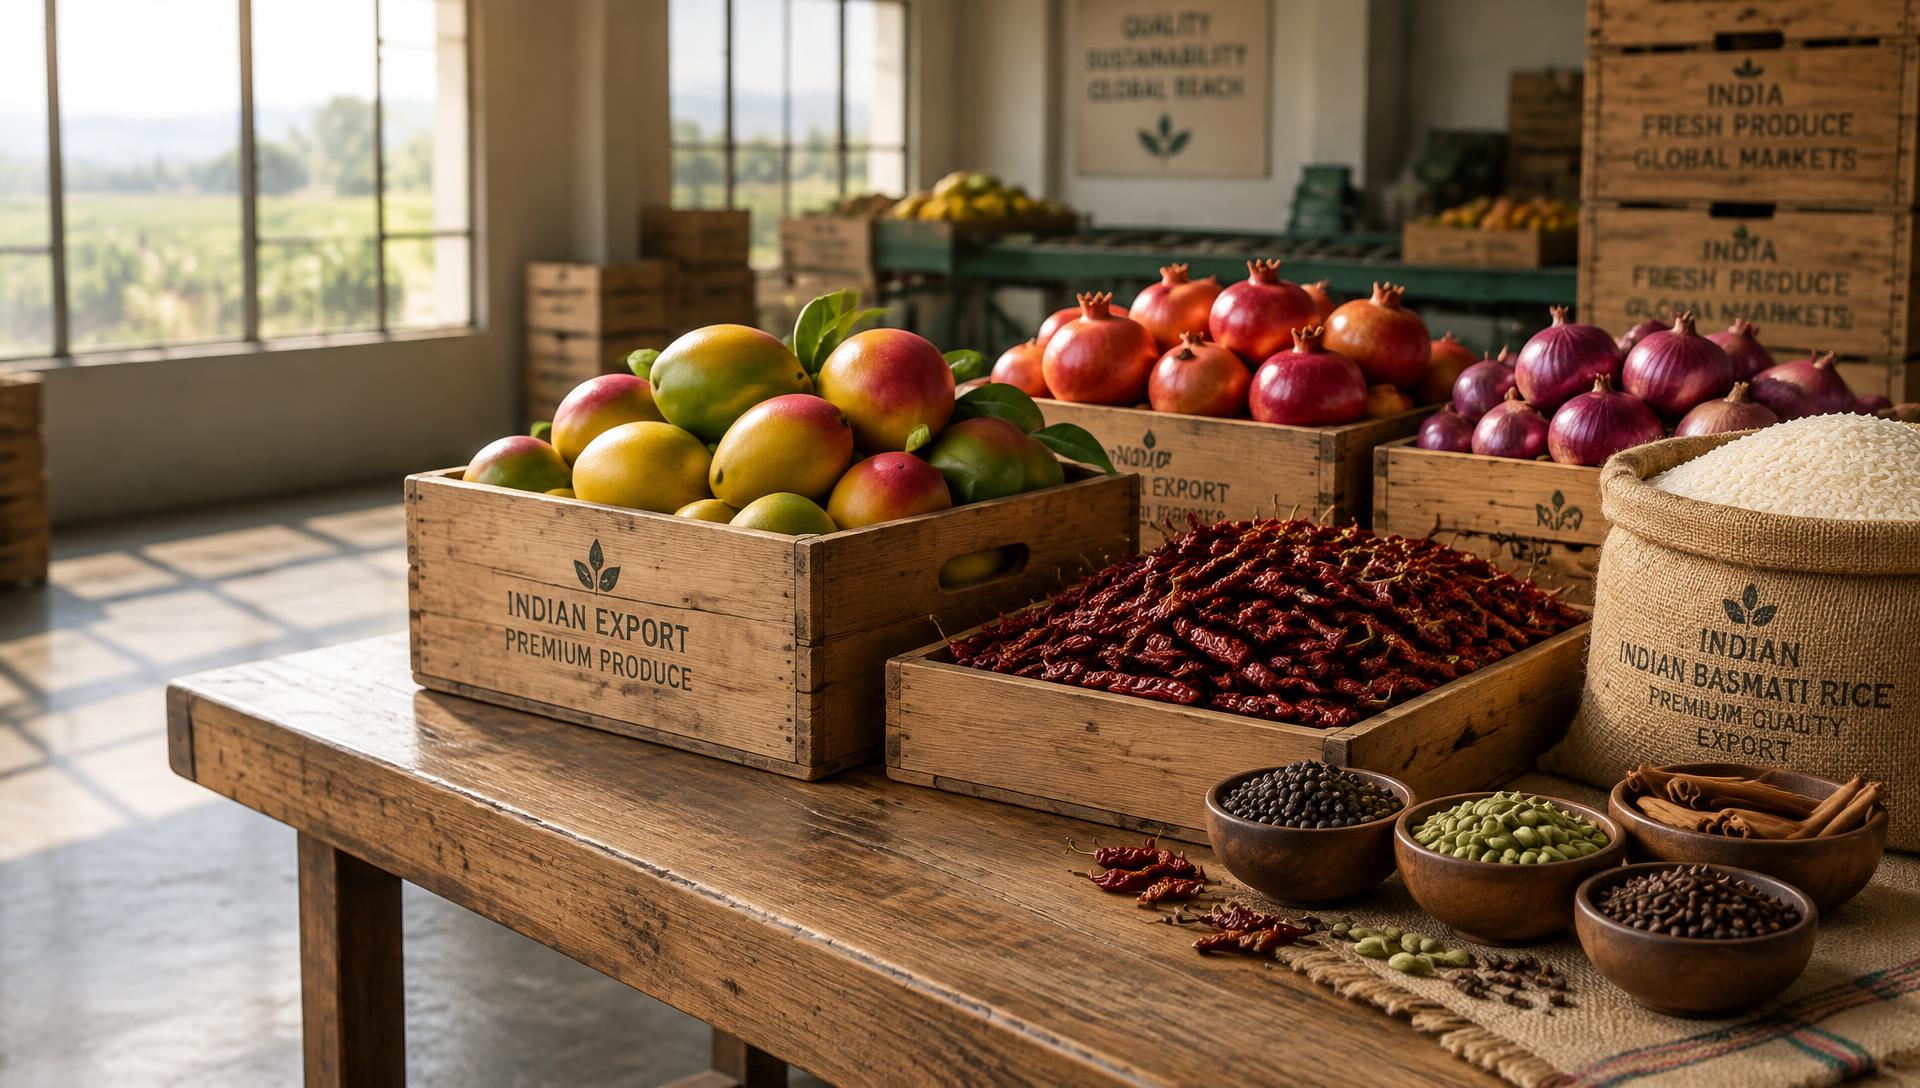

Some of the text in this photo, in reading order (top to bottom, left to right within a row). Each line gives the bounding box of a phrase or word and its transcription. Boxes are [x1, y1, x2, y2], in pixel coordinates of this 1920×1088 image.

[1122, 12, 1212, 38] QUALITY
[1088, 79, 1165, 101] GLOBAL
[1707, 82, 1783, 107] INDIA
[1642, 111, 1854, 138] FRESH PRODUCE
[1633, 147, 1857, 171] GLOBAL MARKETS
[1632, 265, 1717, 291] FRESH
[1153, 477, 1230, 503] EXPORT
[507, 590, 689, 654] INDIAN EXPORT
[505, 627, 693, 692] PREMIUM PRODUCE
[1701, 628, 1801, 668] INDIAN
[1619, 640, 1895, 709] INDIAN BASMATI RICE
[1697, 727, 1792, 762] EXPORT
